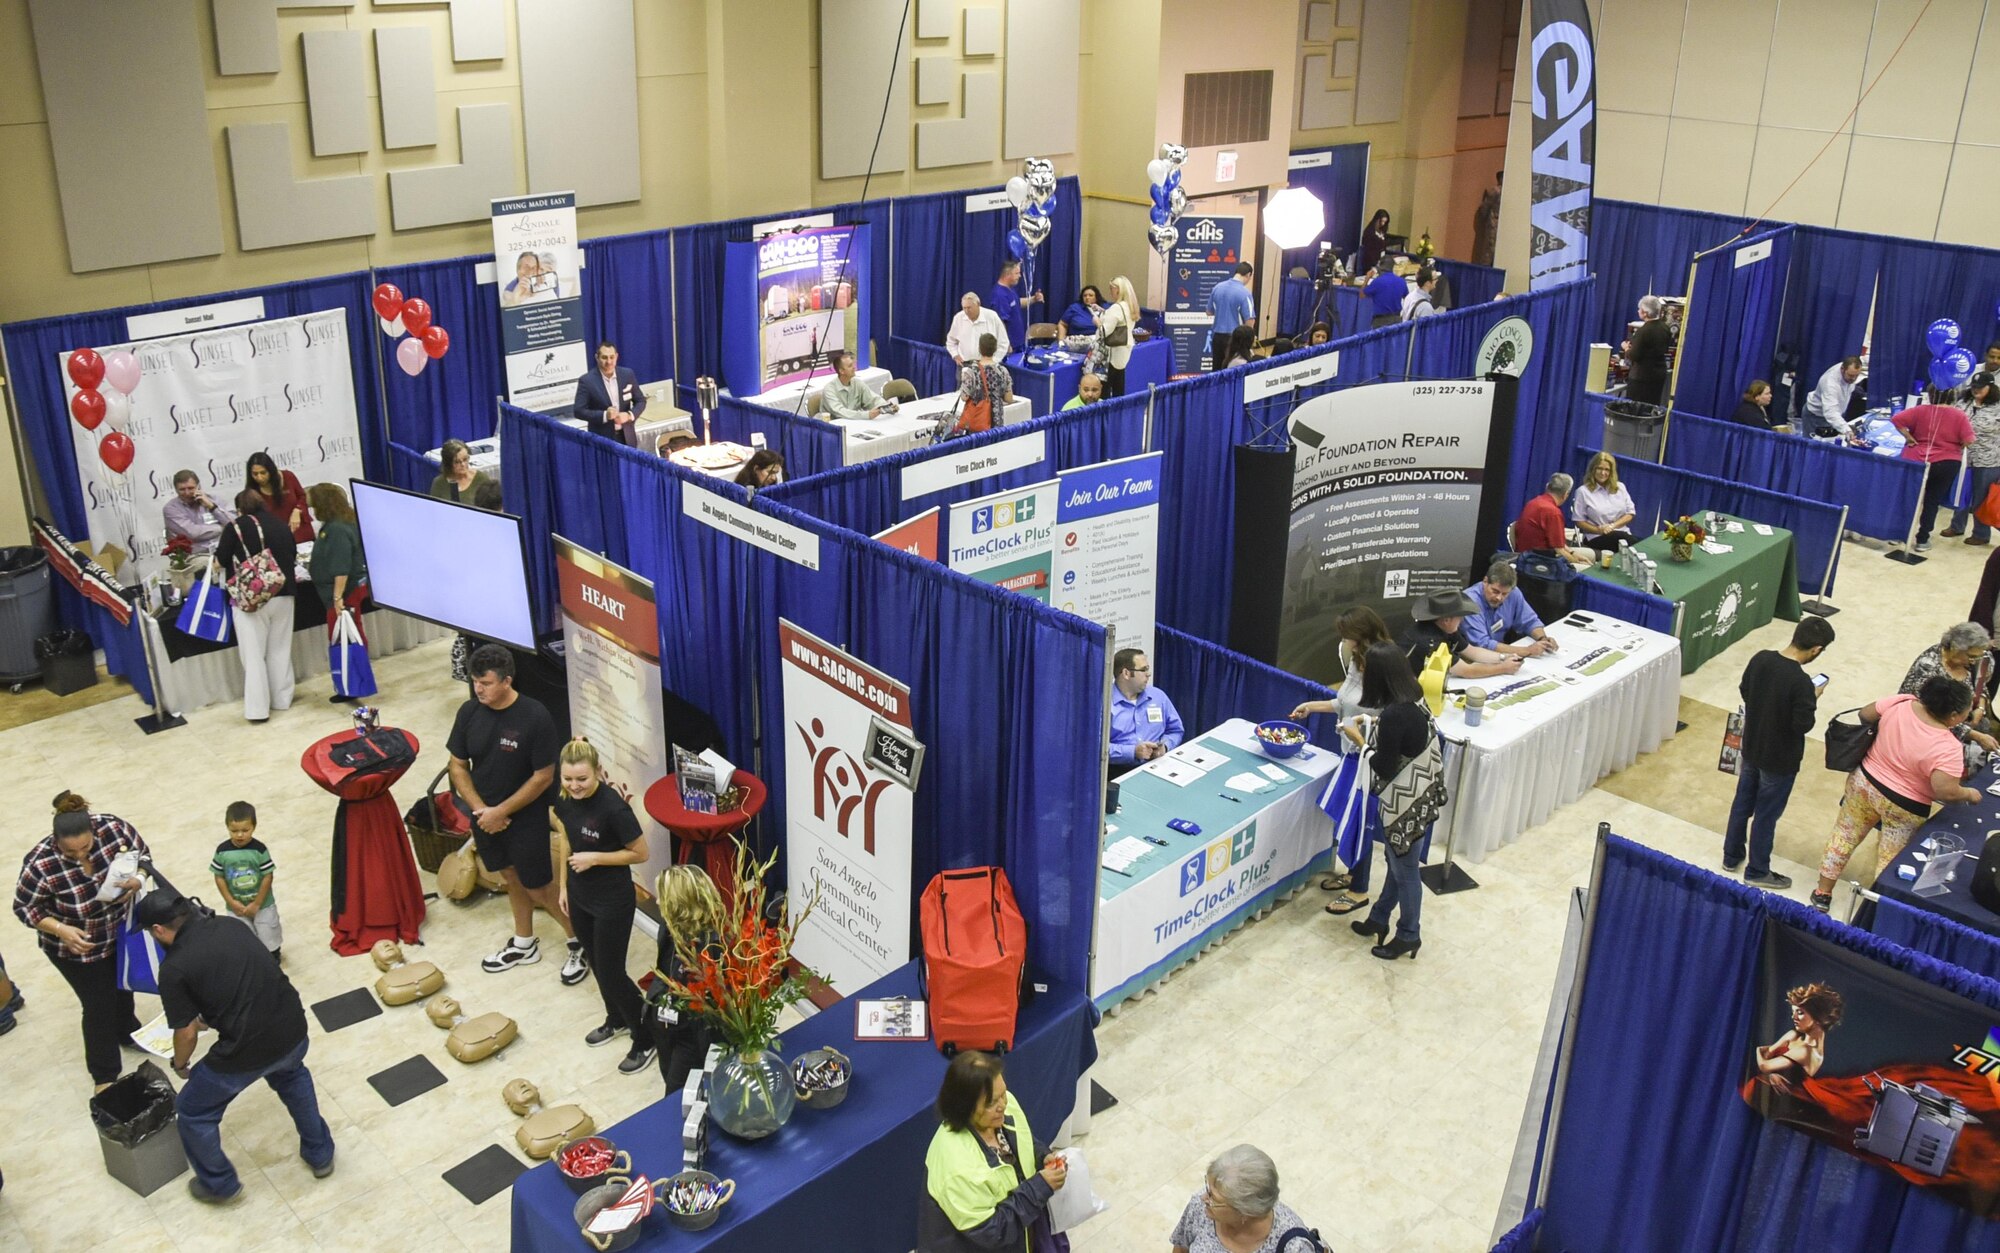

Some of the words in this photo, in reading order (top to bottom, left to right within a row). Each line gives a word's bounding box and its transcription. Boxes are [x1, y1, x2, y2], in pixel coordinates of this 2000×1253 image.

[502, 202, 527, 212] LIVING
[528, 199, 549, 208] MADE
[550, 197, 566, 206] EASY
[511, 215, 561, 232] LYNDALE
[1186, 223, 1224, 240] CHHS
[507, 236, 567, 252] 325-947-0043
[184, 315, 202, 324] Sunset
[203, 313, 214, 321] Mall
[249, 328, 289, 359] SUNSET
[302, 319, 342, 348] SUNSET
[190, 338, 233, 369] SUNSET
[284, 383, 323, 412] SUNSET
[1412, 386, 1436, 396] (325)
[1438, 386, 1483, 395] 227-3758
[170, 405, 213, 435] SUNSET
[229, 394, 269, 424] SUNSET
[317, 435, 355, 463] SUNSET
[1317, 437, 1397, 464] FOUNDATION
[1401, 433, 1460, 449] REPAIR
[208, 458, 243, 488] SUNSE
[956, 464, 969, 475] Time
[970, 460, 985, 471] Clock
[986, 457, 998, 467] Plus
[1319, 463, 1350, 480] VALLEY
[1351, 461, 1371, 472] AND
[1373, 456, 1416, 467] BEYOND
[1065, 490, 1093, 508] Join
[1095, 483, 1119, 502] Our
[1122, 478, 1153, 496] Team
[1309, 484, 1332, 502] WITH
[1333, 483, 1341, 492] A
[1342, 474, 1376, 490] SOLID
[1378, 470, 1469, 484] FOUNDATION.
[1329, 503, 1343, 512] Free
[1344, 496, 1389, 511] Assessments
[1391, 494, 1415, 502] Within
[1444, 493, 1471, 501] Hours
[702, 502, 711, 514] San
[712, 506, 727, 522] Angelo
[728, 514, 755, 536] Community
[756, 525, 777, 543] Medical
[778, 534, 797, 551] Center
[1328, 515, 1350, 527] Locally
[1351, 512, 1375, 522] Owned
[1376, 510, 1382, 518] &
[1384, 507, 1420, 518] Operated
[1327, 530, 1350, 541] Custom
[1352, 525, 1383, 536] Financial
[1384, 521, 1420, 531] Solutions
[127, 534, 167, 563] SUNSE
[952, 533, 1022, 563] TimeClock
[990, 548, 1010, 561] better
[1010, 544, 1029, 556] sense
[1029, 542, 1037, 551] of
[1060, 547, 1080, 555] Benefits
[1325, 544, 1350, 556] Lifetime
[1351, 537, 1394, 550] Transferable
[1396, 535, 1431, 545] Warranty
[1091, 558, 1125, 569] Comprehensive
[1126, 553, 1144, 562] Training
[1091, 568, 1117, 577] Educational
[1117, 562, 1141, 571] Assistance
[1324, 556, 1357, 571] Pier/Beam
[1364, 552, 1380, 561] Slab
[1381, 549, 1429, 561] Foundations
[1107, 572, 1127, 582] Lunches
[1387, 579, 1406, 587] BBB
[581, 583, 626, 621] HEART
[617, 653, 636, 669] reach.
[791, 639, 898, 715] www.SACMC.com
[877, 735, 909, 759] Hands
[881, 747, 901, 766] Only
[816, 846, 838, 874] San
[837, 865, 877, 902] Angelo
[810, 866, 882, 933] Community
[1153, 879, 1236, 945] TimeClock
[1198, 909, 1221, 927] better
[847, 918, 888, 961] Center
